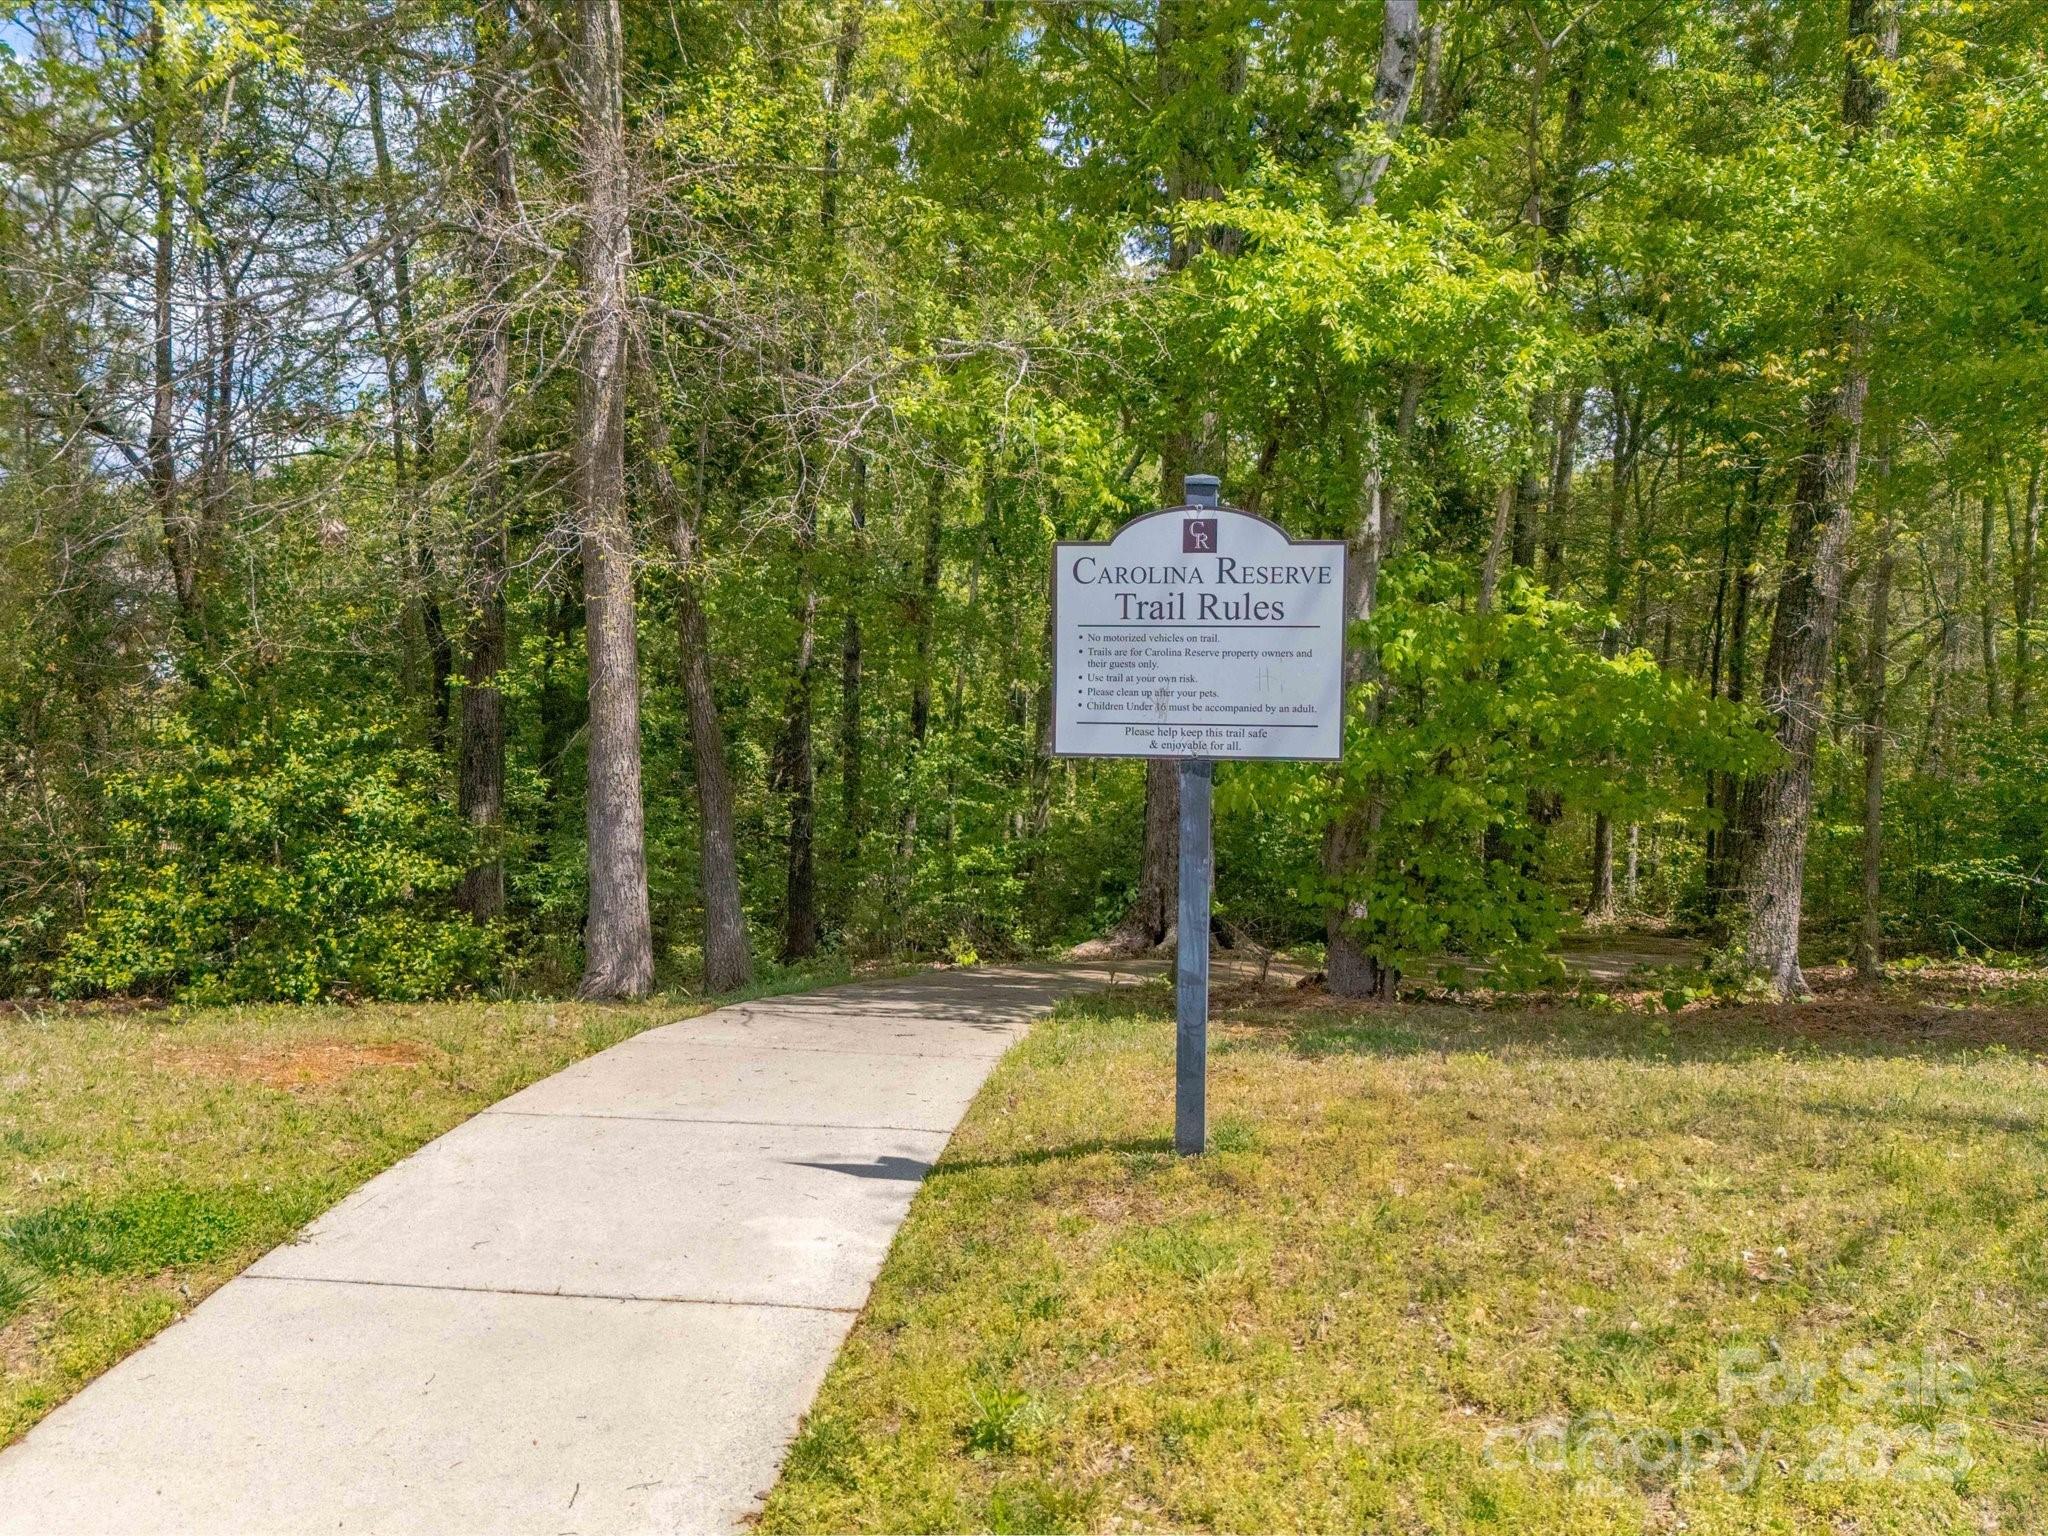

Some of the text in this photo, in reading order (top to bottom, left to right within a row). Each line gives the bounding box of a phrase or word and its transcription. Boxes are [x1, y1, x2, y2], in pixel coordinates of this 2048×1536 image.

[1072, 556, 1332, 585] CAROLINA RESERVE
[1115, 592, 1284, 620] Trail Rules
[1087, 634, 1100, 642] No
[1103, 634, 1147, 642] motorized
[1149, 634, 1184, 642] vehicles
[1200, 634, 1220, 643] trail.
[1088, 648, 1114, 657] Trails
[1130, 648, 1143, 657] for
[1144, 648, 1182, 658] Carolina
[1184, 649, 1219, 658] Reserve
[1222, 650, 1259, 660] property
[1261, 650, 1294, 658] owners
[1296, 649, 1312, 658] and
[1087, 660, 1159, 670] their guests only.
[1087, 674, 1104, 682] Use
[1106, 674, 1124, 682] trail
[1136, 676, 1156, 684] your
[1179, 674, 1198, 683] risk.
[1087, 688, 1218, 698] Please clean up after your pets.
[1086, 702, 1124, 711] Children
[1126, 702, 1154, 712] Under
[1155, 702, 1166, 712] 16
[1168, 704, 1190, 712] must
[1192, 703, 1203, 712] be
[1205, 704, 1262, 714] accompanied
[1265, 705, 1276, 714] by
[1292, 704, 1318, 714] adult.
[1125, 727, 1268, 739] Please help keep this trail safe
[1150, 741, 1242, 750] & enjoyable for all.
